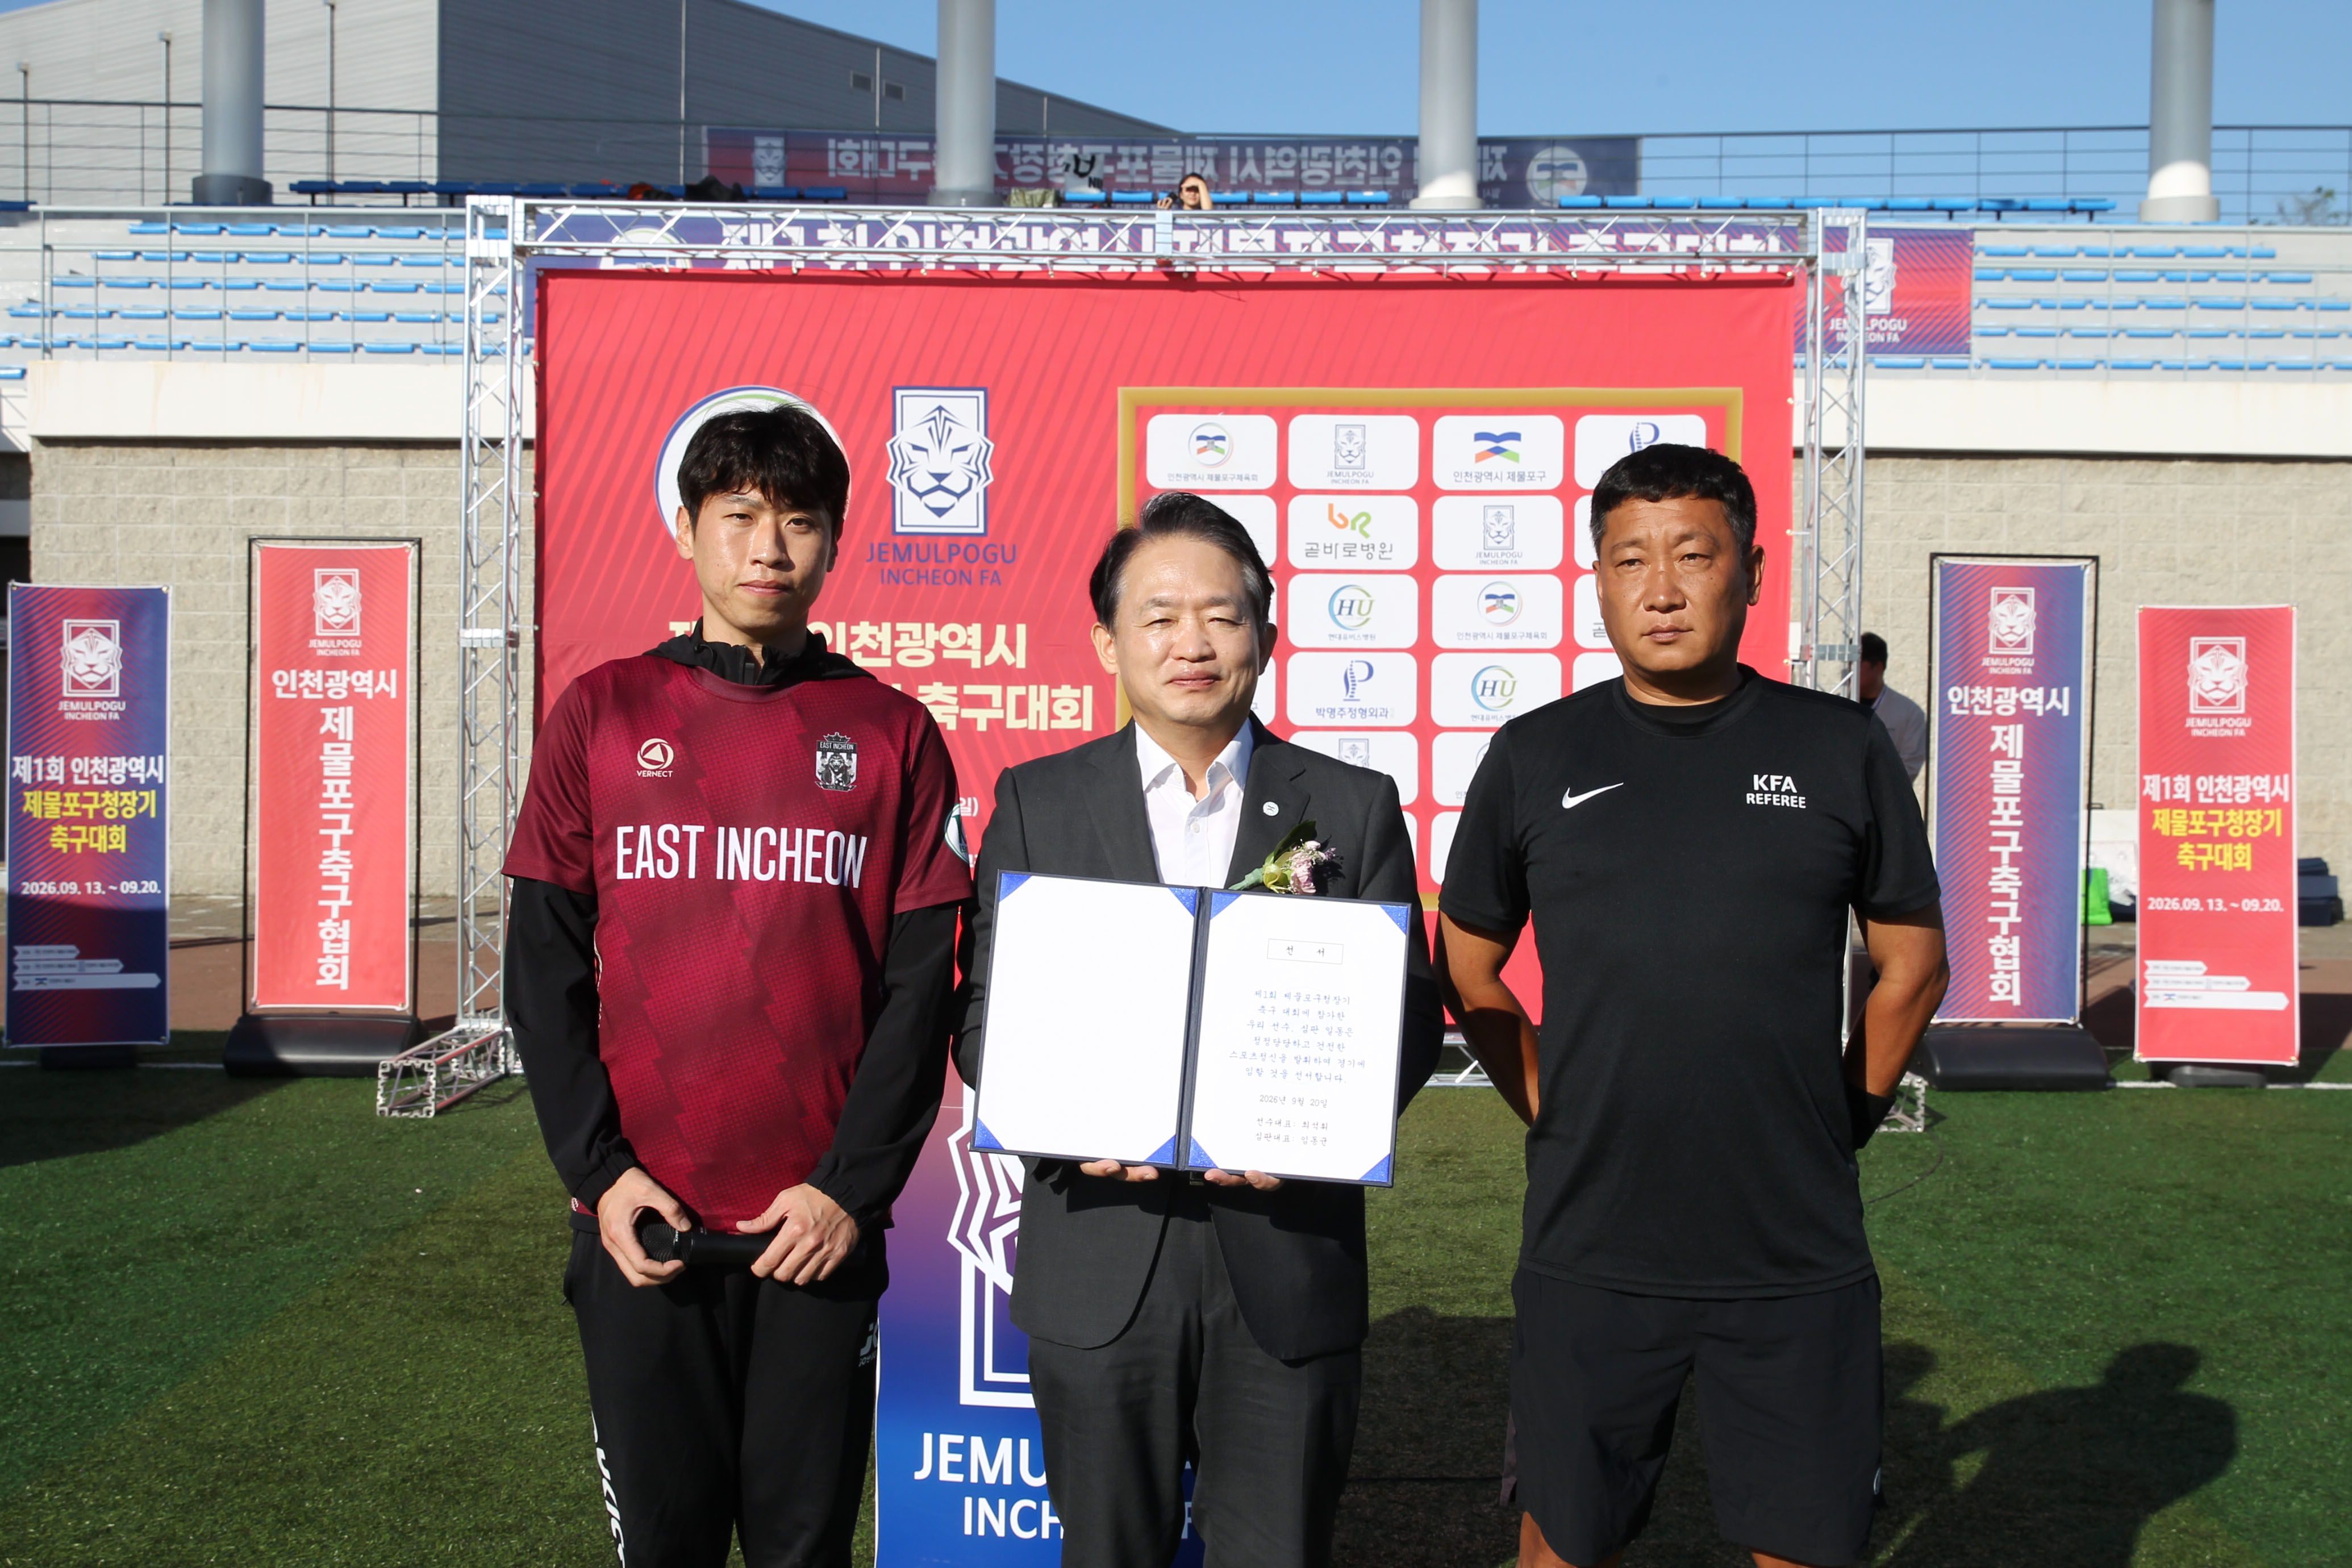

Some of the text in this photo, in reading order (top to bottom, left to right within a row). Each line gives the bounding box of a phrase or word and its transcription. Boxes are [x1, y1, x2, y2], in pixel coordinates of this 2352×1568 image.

[1167, 473, 1204, 482] 인천광역시
[1453, 471, 1546, 483] 인천광역시 제물포구
[866, 542, 1017, 564] JEMULPOGU
[1304, 541, 1393, 560] 곧바로병원
[881, 569, 1002, 585] INCHEON FA
[308, 639, 362, 648] JEMULPOGU
[1456, 632, 1494, 641] 인천광역시
[1981, 657, 2034, 667] JEMULPOGU
[272, 669, 397, 699] 인천광역시
[58, 700, 126, 711] JEMULPOGU
[916, 682, 1093, 732] 축구대회
[1948, 685, 2070, 717] 인천광역시
[64, 712, 107, 720] INCHEON
[2184, 718, 2251, 728] JEMULPOGU
[2191, 728, 2233, 737] INCHEON
[12, 755, 164, 785] 제1회 인천광역시
[1753, 774, 1798, 793] KFA
[2142, 774, 2290, 804] 제1회 인천광역시
[23, 789, 157, 819] 제물포구청장기
[1746, 793, 1807, 809] REFEREE
[2151, 808, 2282, 838] 제물포구청장기
[50, 824, 127, 854] 축구대회
[316, 706, 355, 990] 제물포구축구협회
[616, 824, 868, 889] EAST INCHEON
[1988, 724, 2024, 1006] 제물포구축구협회
[2176, 842, 2252, 871] 축구대회
[1254, 989, 1277, 999] 제1회
[1257, 1004, 1345, 1021] 축구 대회에 참가한
[1247, 1019, 1265, 1029] 우리
[1300, 1024, 1320, 1035] 심판
[1325, 1026, 1354, 1037] 일동은
[1253, 1036, 1346, 1052] 정정당당하고 건전한
[1228, 1050, 1366, 1069] 스포츠정신을 발휘하여 경기에
[1245, 1067, 1264, 1077] 임할
[1270, 1068, 1289, 1079] 것을
[1259, 1094, 1328, 1108] 2026년 9월 20일
